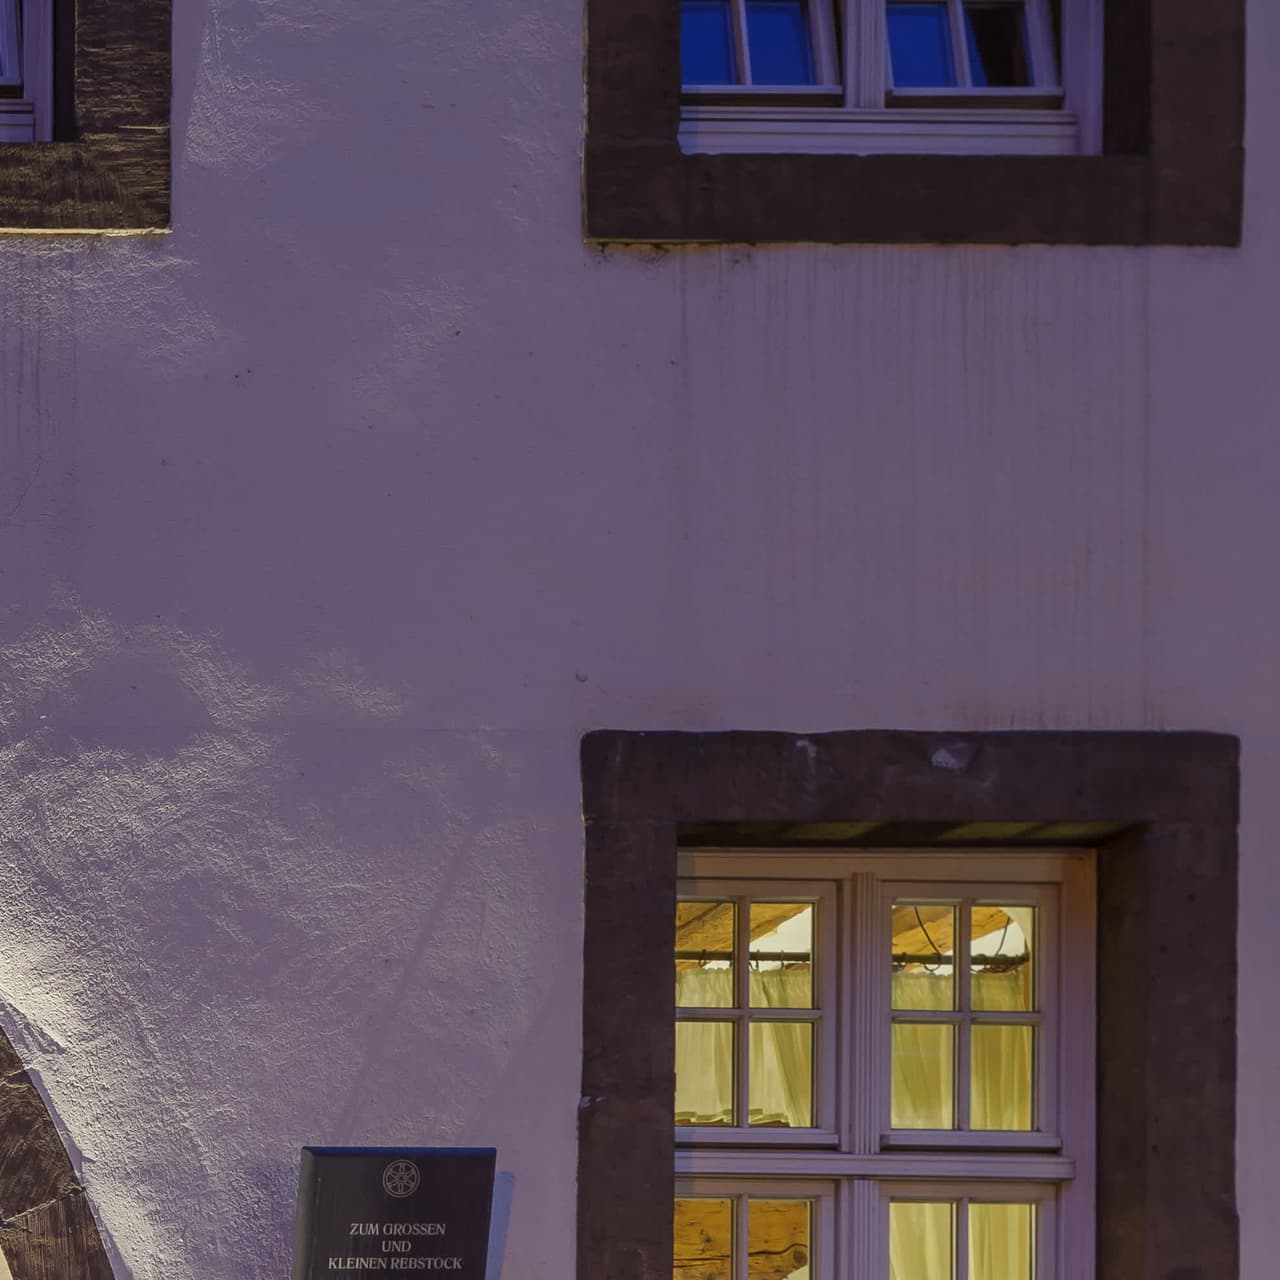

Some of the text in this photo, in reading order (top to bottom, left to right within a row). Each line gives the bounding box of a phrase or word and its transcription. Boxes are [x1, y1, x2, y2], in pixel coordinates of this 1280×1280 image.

[349, 1223, 446, 1236] ZUM GROSSEN
[381, 1240, 412, 1253] UND
[328, 1257, 463, 1270] KLEINEN REBSTOCK
